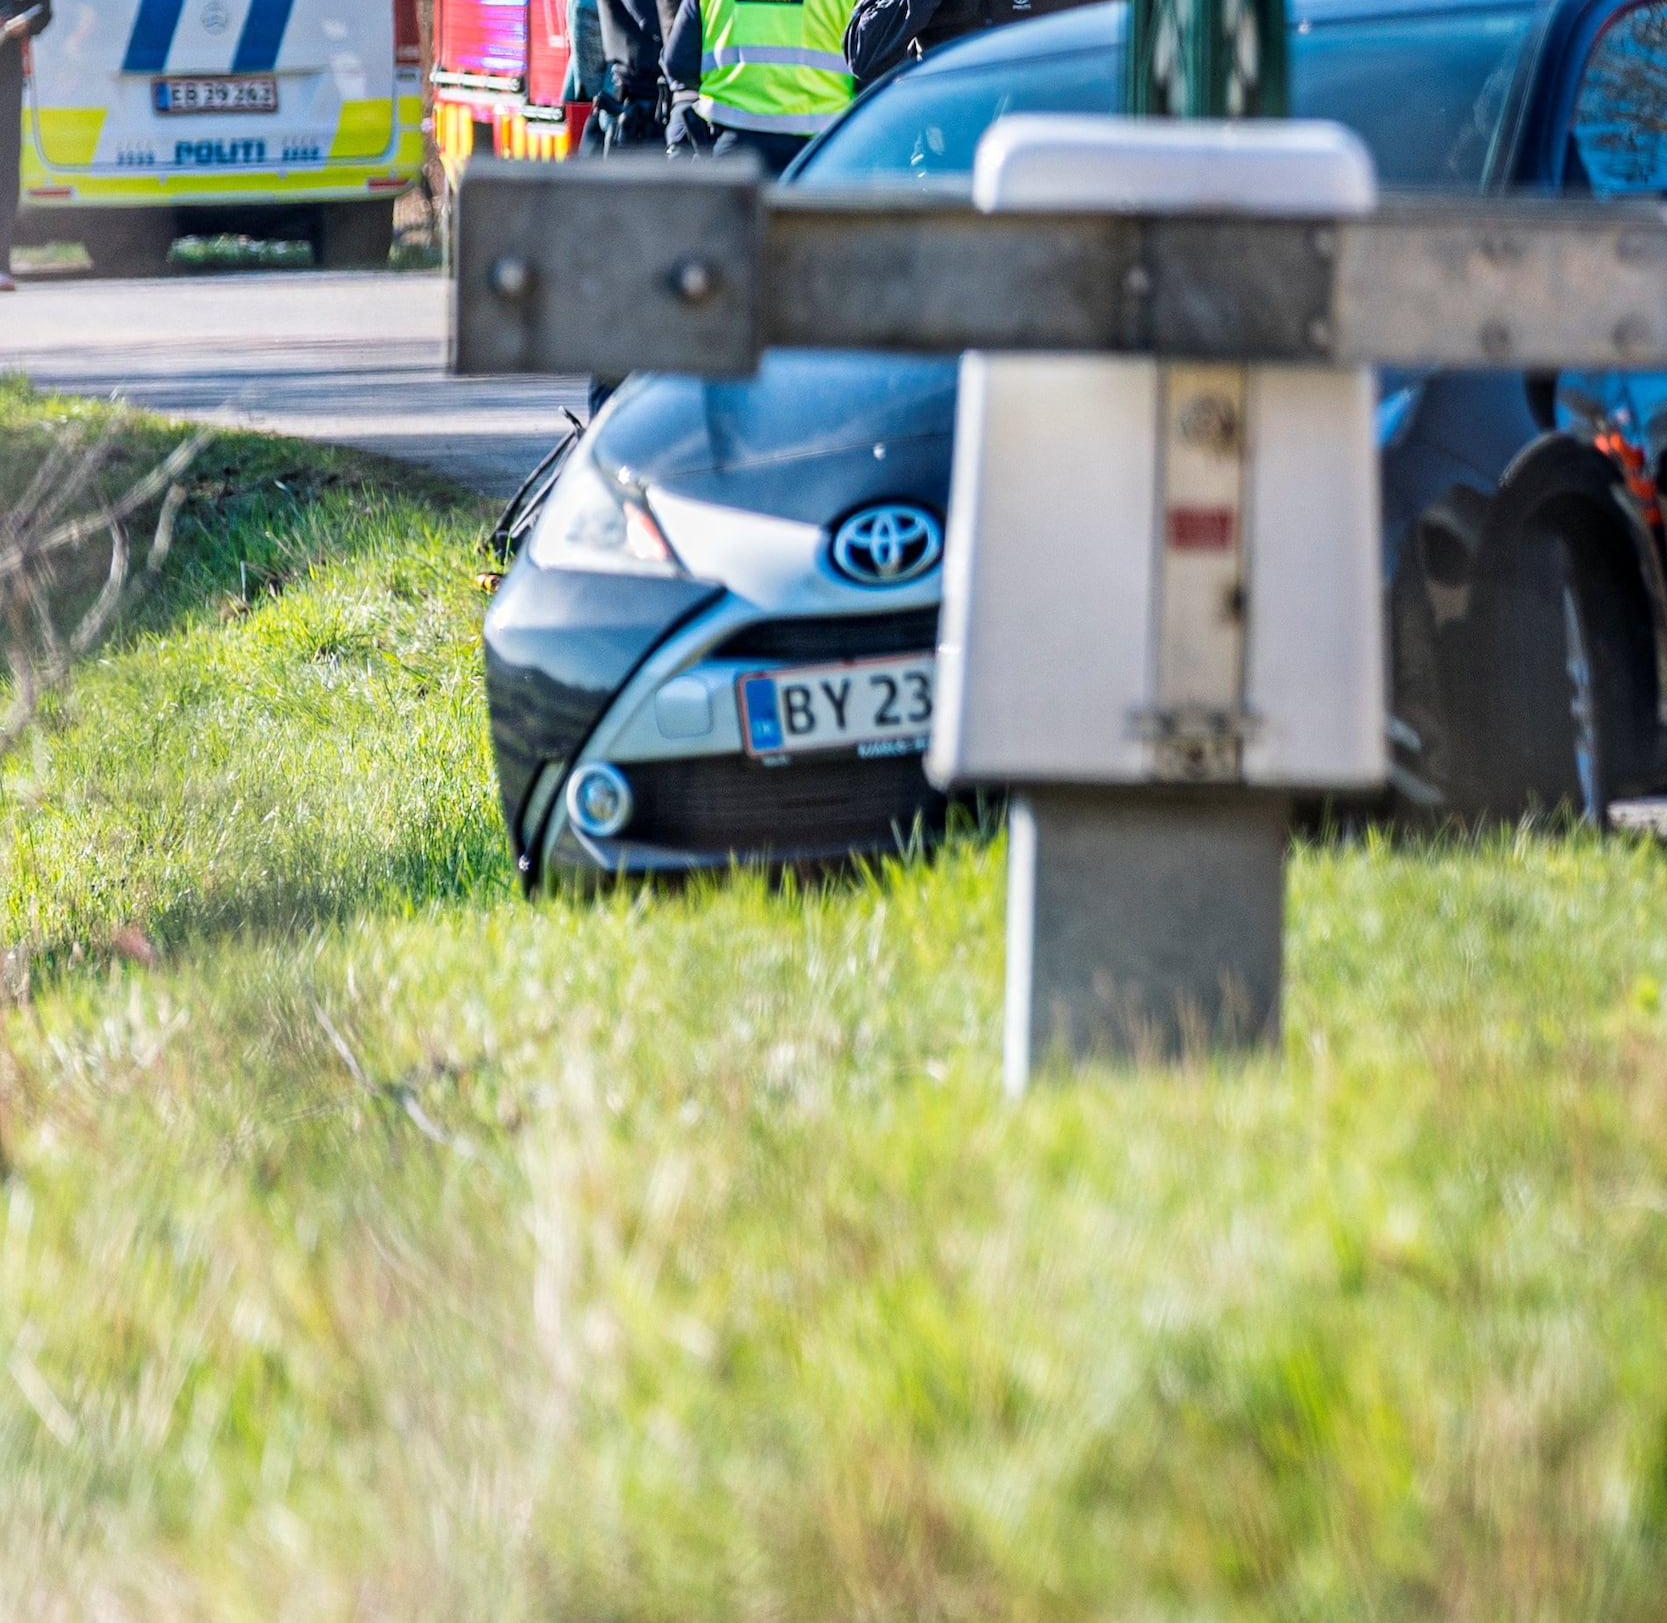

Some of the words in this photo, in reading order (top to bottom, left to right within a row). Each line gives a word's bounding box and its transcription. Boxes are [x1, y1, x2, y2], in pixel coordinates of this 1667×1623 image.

[174, 137, 266, 165] POLITI
[783, 677, 850, 735] BY
[871, 671, 932, 724] 23
